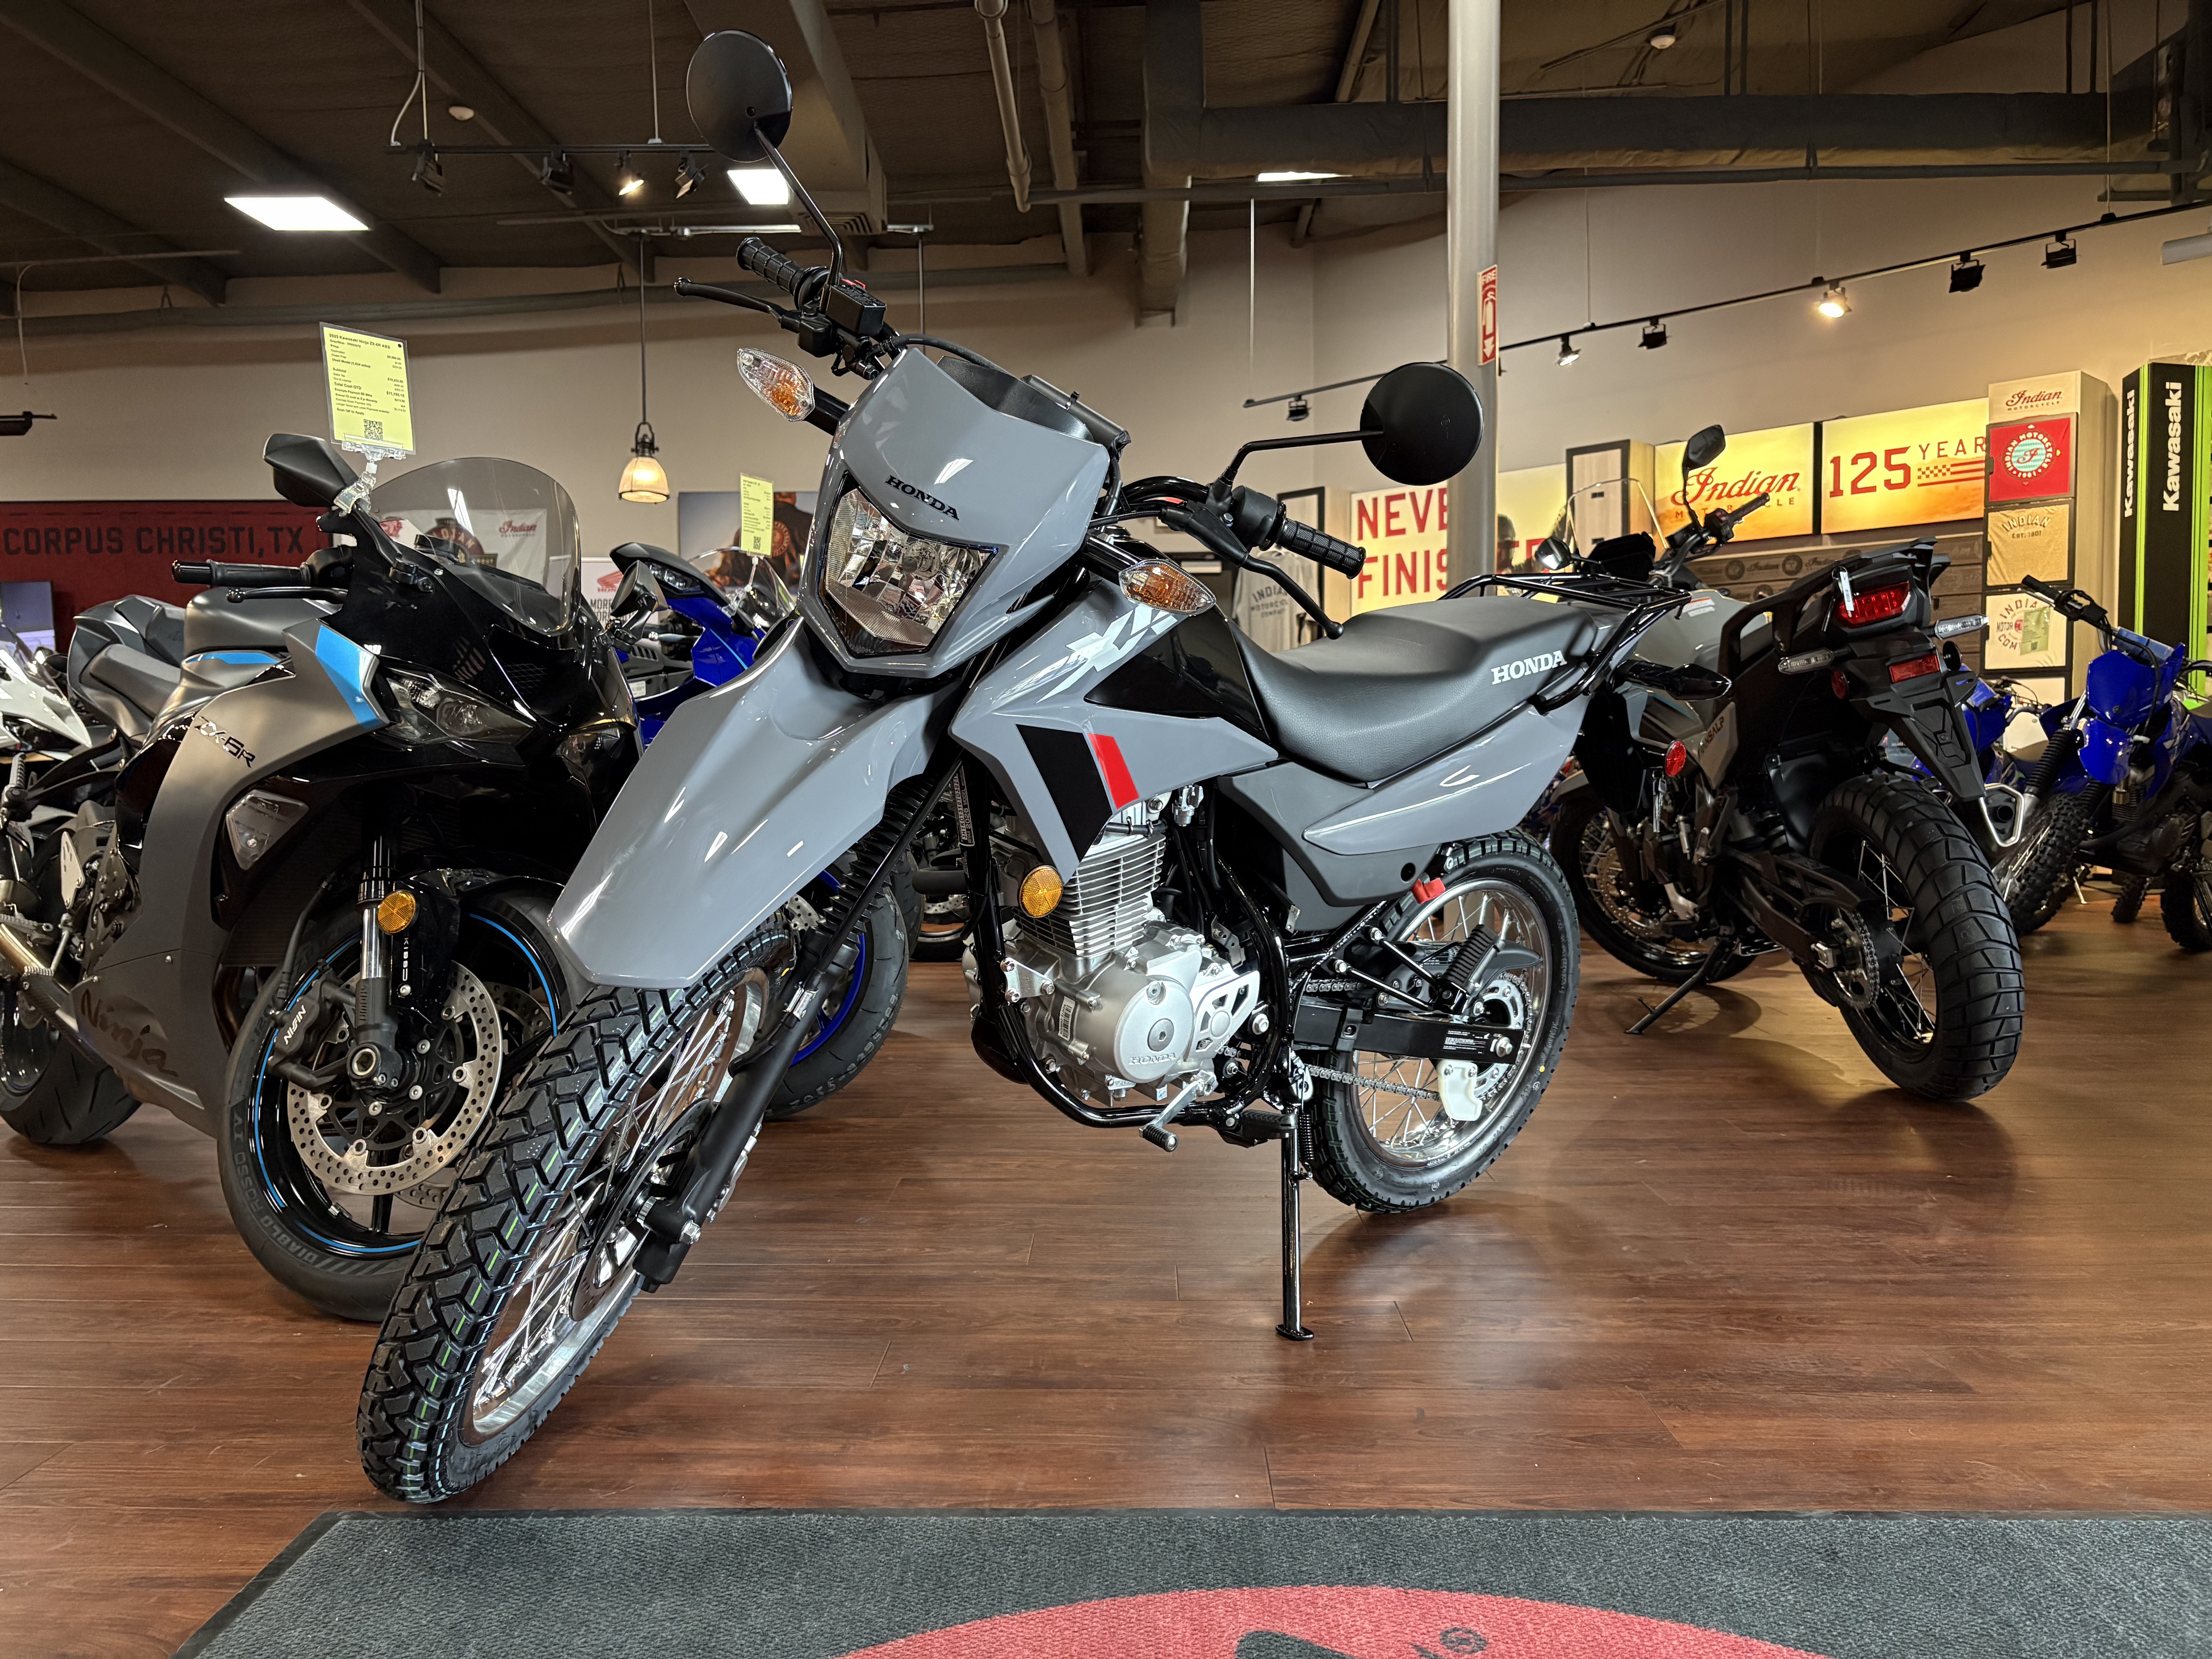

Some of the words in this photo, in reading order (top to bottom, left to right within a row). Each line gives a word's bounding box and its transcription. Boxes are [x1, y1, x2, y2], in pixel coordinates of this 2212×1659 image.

[1481, 270, 1496, 286] FIRE
[2006, 390, 2062, 407] Indian
[2124, 390, 2135, 517] Kawasaki
[2163, 382, 2181, 511] Kawasaki
[1829, 446, 1911, 498] 125
[1918, 436, 1986, 460] YEAR
[885, 475, 960, 521] HONDA
[1671, 467, 1800, 506] Indian
[3, 527, 123, 555] CORPUS
[499, 519, 537, 534] Indian
[2002, 514, 2051, 532] INDIAN
[1358, 548, 1447, 599] FINIS
[1996, 621, 2013, 633] MOTOR
[1999, 598, 2038, 619] INDIA
[1998, 634, 2021, 650] COM
[1491, 650, 1568, 685] HONDA
[194, 716, 256, 769] ZX-6R
[81, 988, 179, 1077] Ninja
[1128, 1053, 1177, 1065] HONDA
[235, 1152, 263, 1212] ROSSO
[260, 1215, 320, 1264] DIABLO
